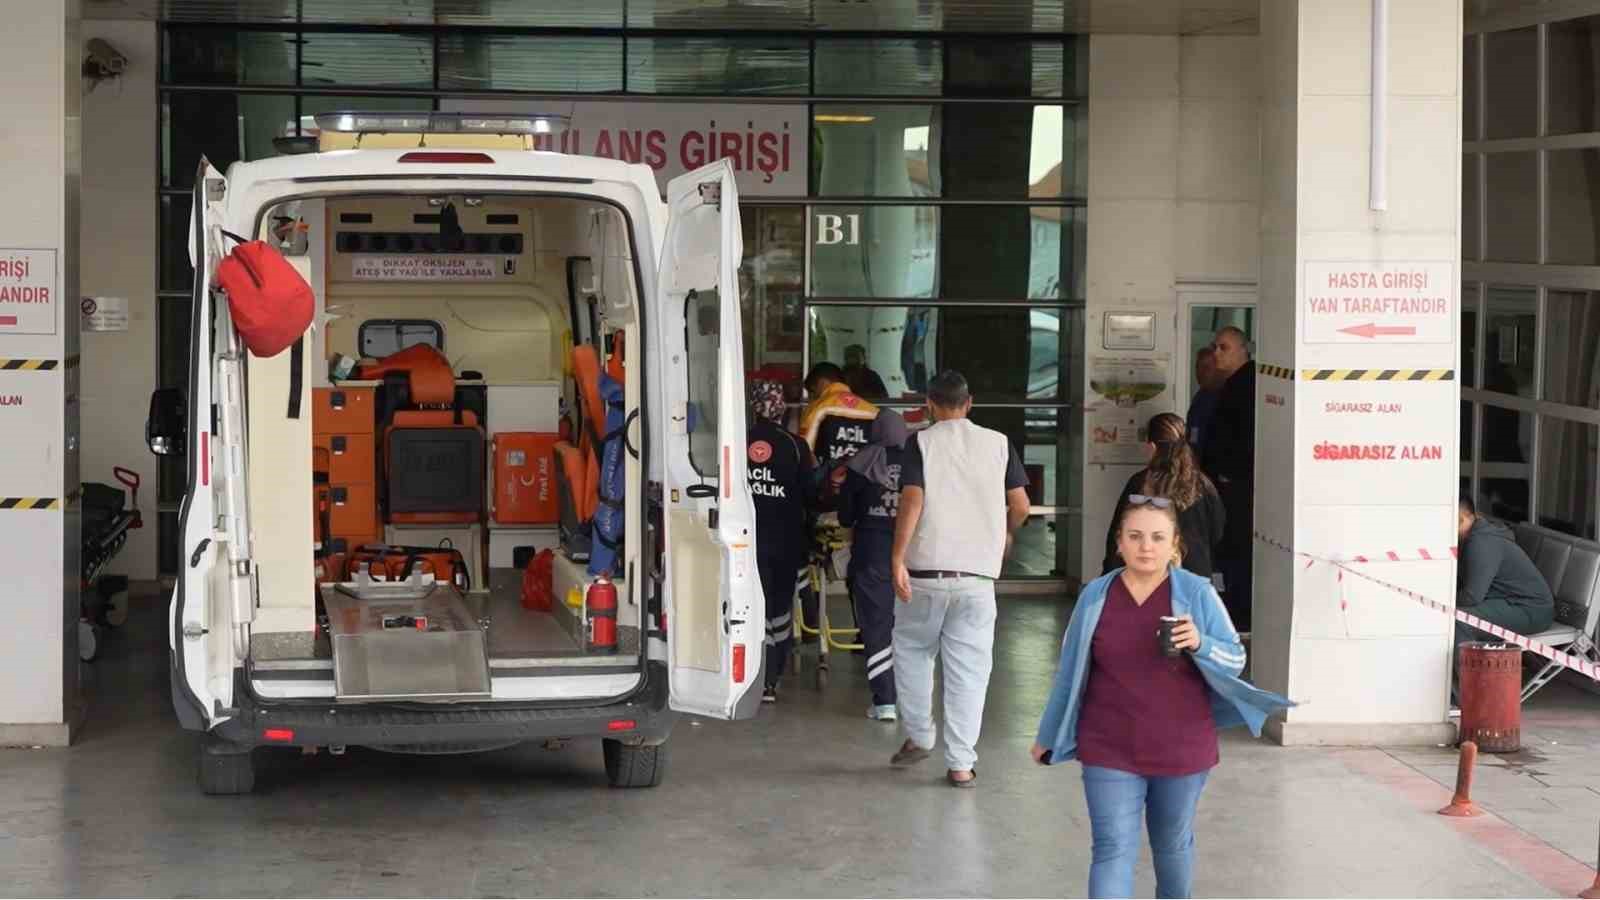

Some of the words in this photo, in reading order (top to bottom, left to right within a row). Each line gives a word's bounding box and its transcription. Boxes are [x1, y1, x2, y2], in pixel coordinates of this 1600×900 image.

[679, 120, 790, 184] GİRİŞİ
[1328, 272, 1378, 289] HASTA
[1382, 267, 1428, 293] GİRİŞİ
[1309, 298, 1338, 313] YAN
[1343, 298, 1447, 313] TARAFTANDIR
[1378, 403, 1402, 413] ALAN
[1313, 440, 1396, 460] SİGARASIZ
[1401, 446, 1442, 460] ALAN
